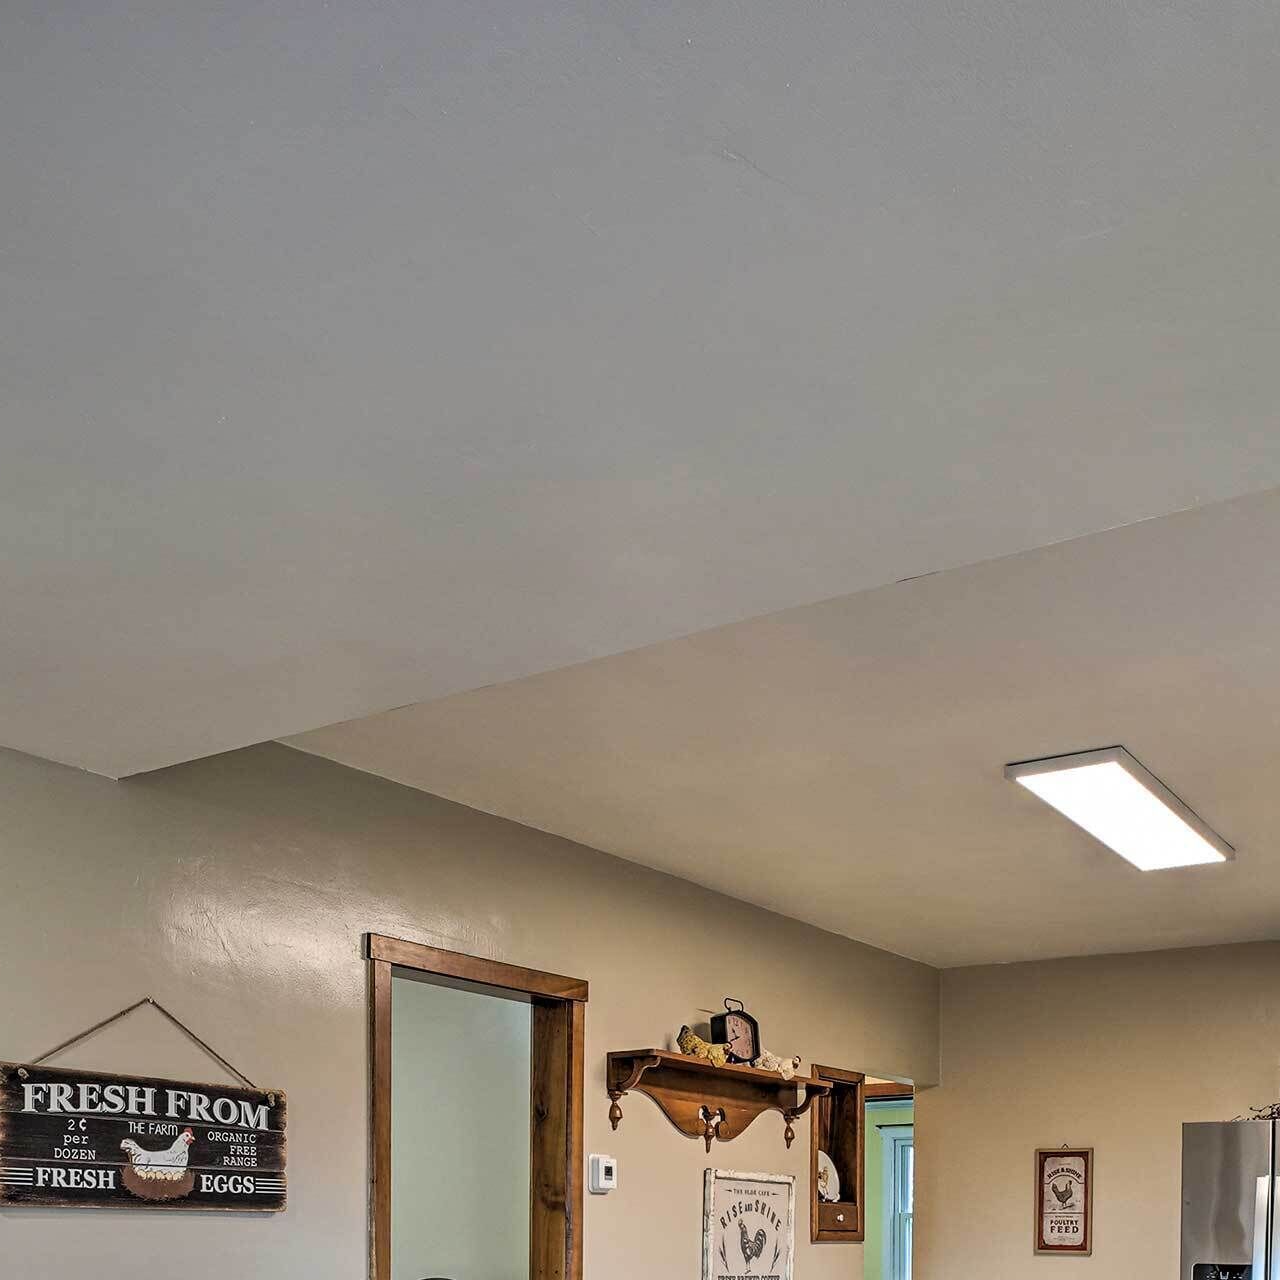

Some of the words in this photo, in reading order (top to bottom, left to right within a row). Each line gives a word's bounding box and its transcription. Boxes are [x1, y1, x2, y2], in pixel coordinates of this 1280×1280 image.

[21, 1083, 158, 1116] FRESH
[165, 1088, 272, 1131] FROM
[128, 1121, 145, 1134] THE
[148, 1124, 178, 1136] FARM
[63, 1134, 89, 1146] per
[207, 1131, 257, 1144] ORGANIC
[54, 1147, 96, 1160] DOZEN
[229, 1145, 257, 1156] FREE
[223, 1156, 258, 1167] RANGE
[35, 1167, 116, 1190] FRESH
[200, 1174, 255, 1194] EGGS
[720, 1201, 743, 1229] RISE
[755, 1199, 782, 1231] SHINE
[1050, 1226, 1079, 1234] FEED
